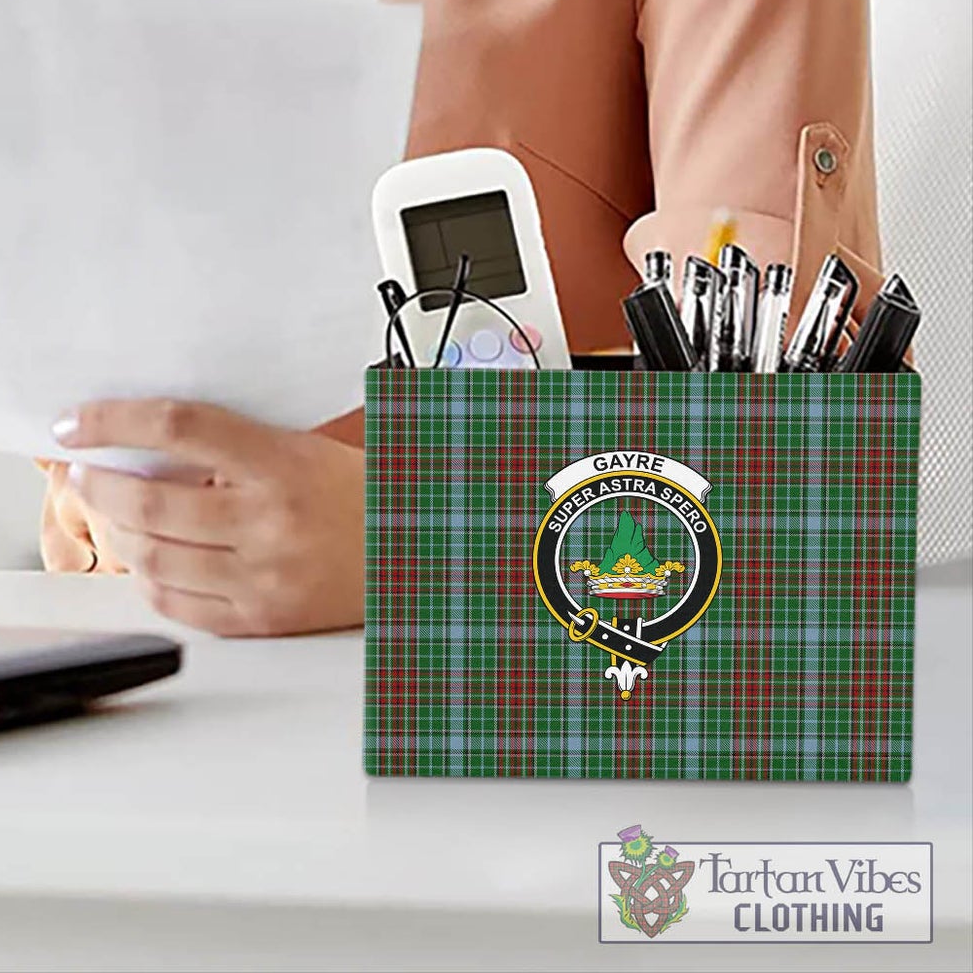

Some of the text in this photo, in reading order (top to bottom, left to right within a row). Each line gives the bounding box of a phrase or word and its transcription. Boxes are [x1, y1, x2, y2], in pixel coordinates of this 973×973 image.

[593, 453, 665, 473] GAYRE
[548, 478, 707, 533] SUPER ASTRA SPERO
